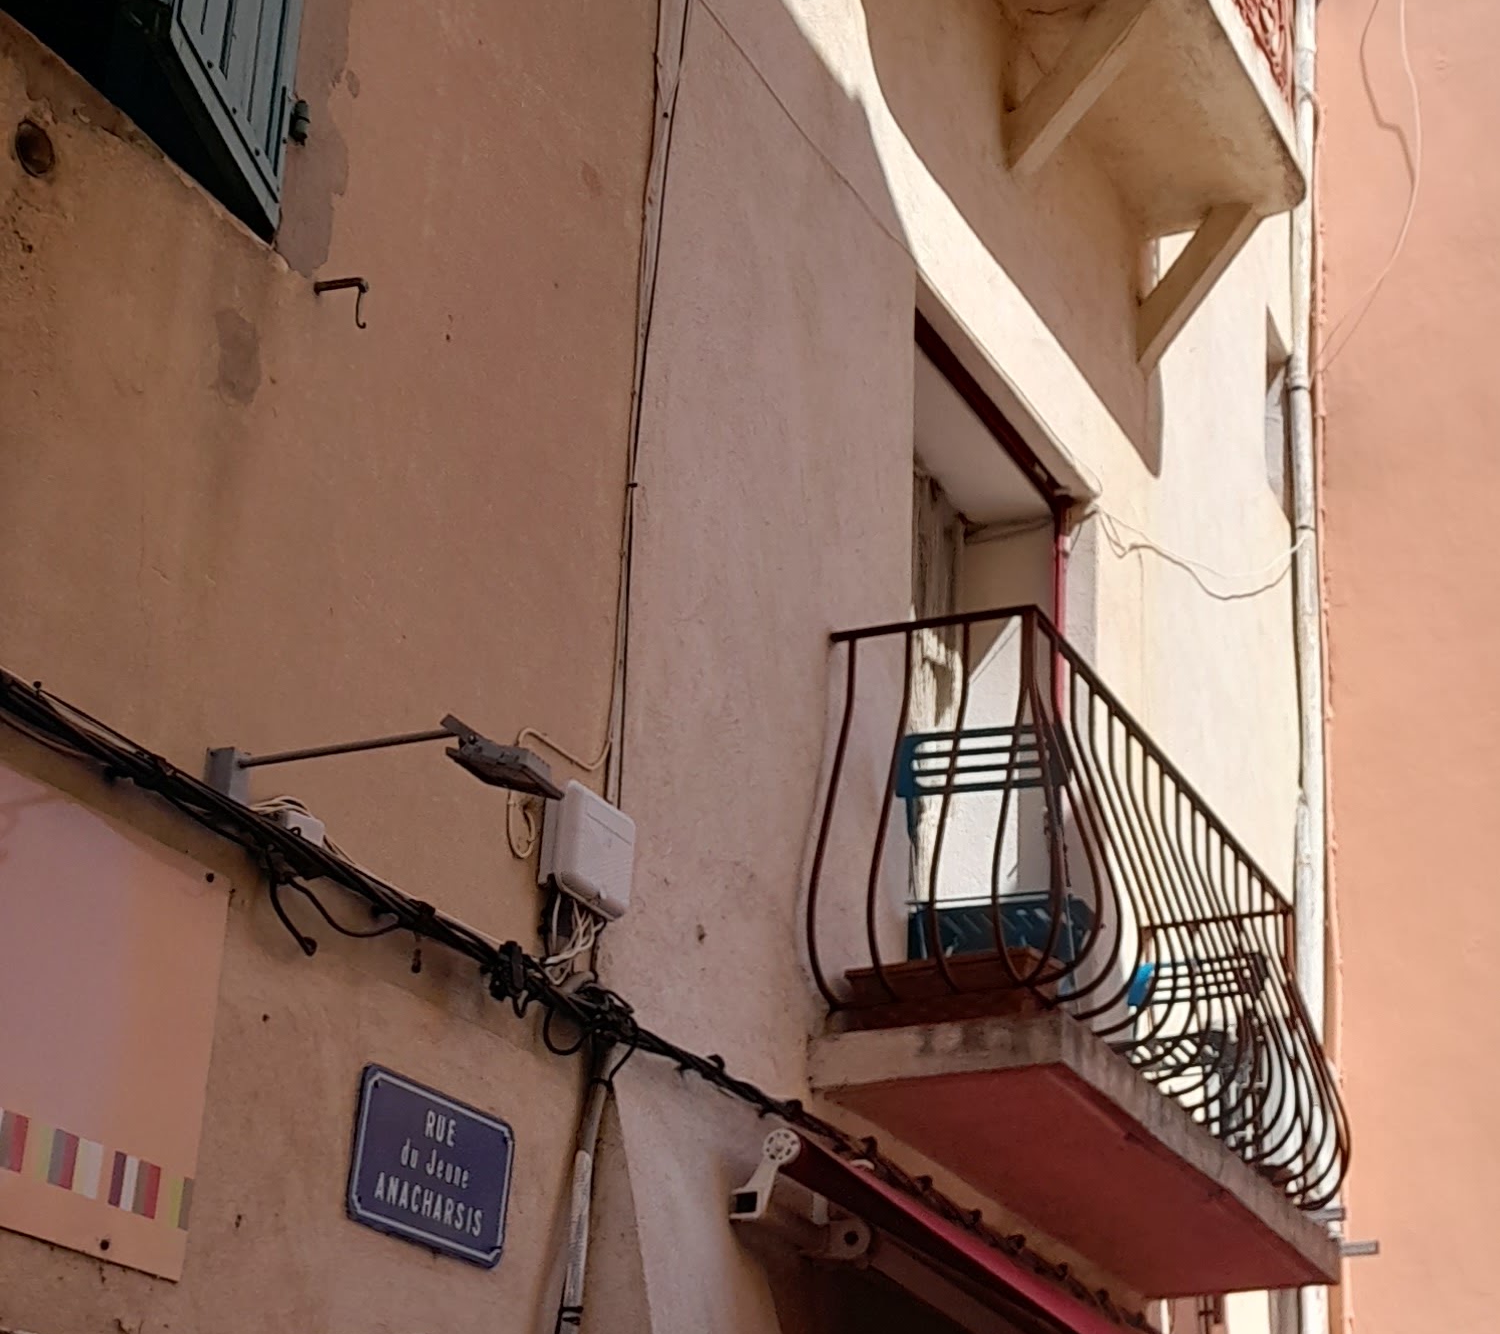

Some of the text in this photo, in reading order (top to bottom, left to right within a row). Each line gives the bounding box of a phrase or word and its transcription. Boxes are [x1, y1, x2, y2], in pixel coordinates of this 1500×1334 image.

[424, 1109, 457, 1148] RUE
[399, 1138, 470, 1190] du Jeune
[373, 1170, 484, 1237] ANACHARSIS
